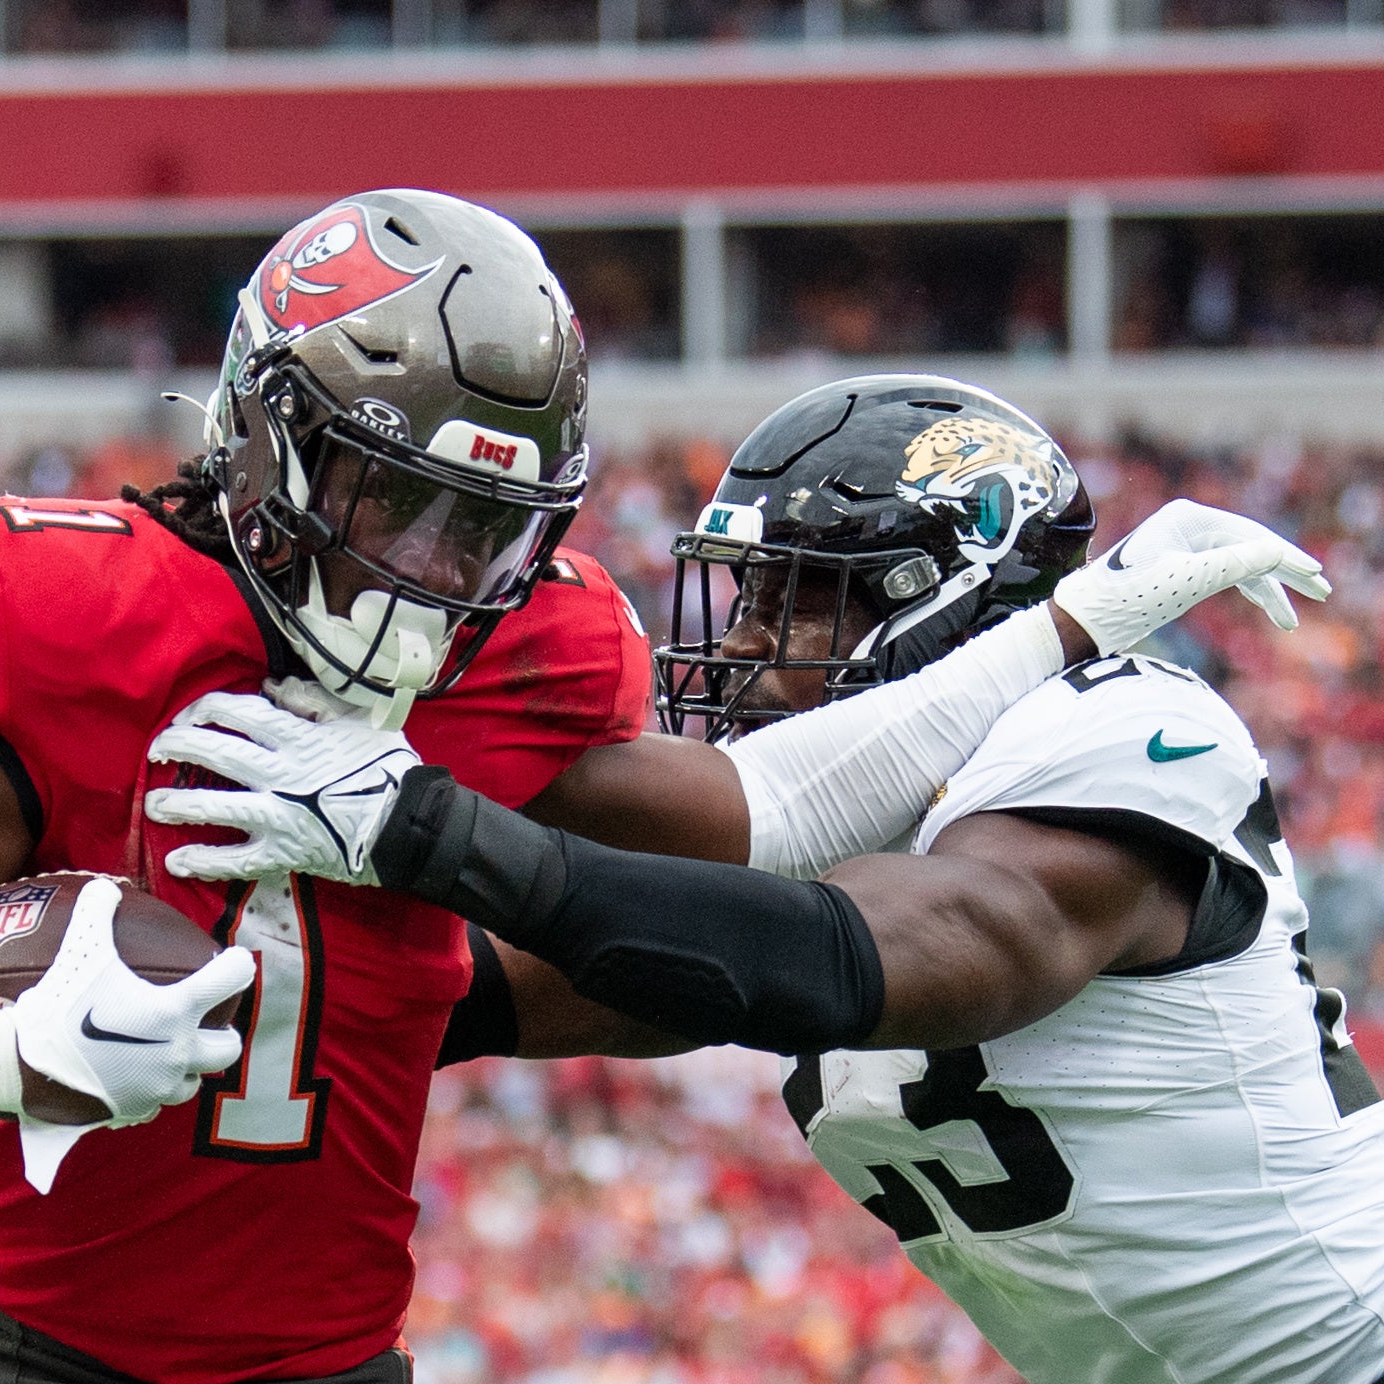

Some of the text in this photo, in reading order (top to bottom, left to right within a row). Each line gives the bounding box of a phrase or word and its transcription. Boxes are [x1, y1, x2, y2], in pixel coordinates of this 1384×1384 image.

[350, 409, 405, 441] OAKLEY
[704, 508, 734, 535] JAX
[191, 870, 333, 1166] 1
